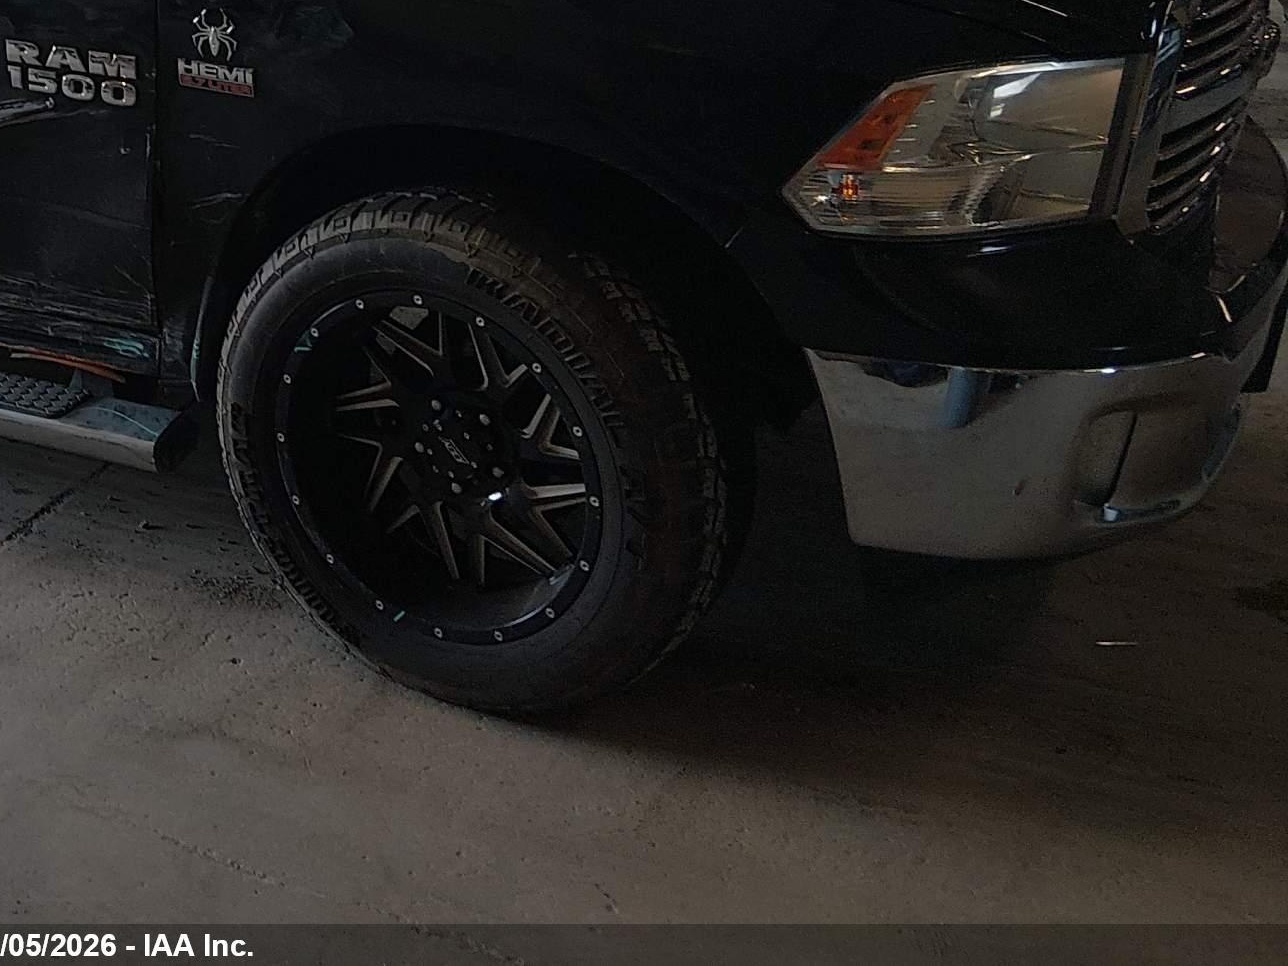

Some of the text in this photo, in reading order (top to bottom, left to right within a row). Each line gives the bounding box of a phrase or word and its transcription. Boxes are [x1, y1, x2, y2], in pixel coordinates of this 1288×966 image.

[4, 38, 137, 80] RAM
[177, 57, 255, 85] HEMI
[6, 64, 137, 107] 1500
